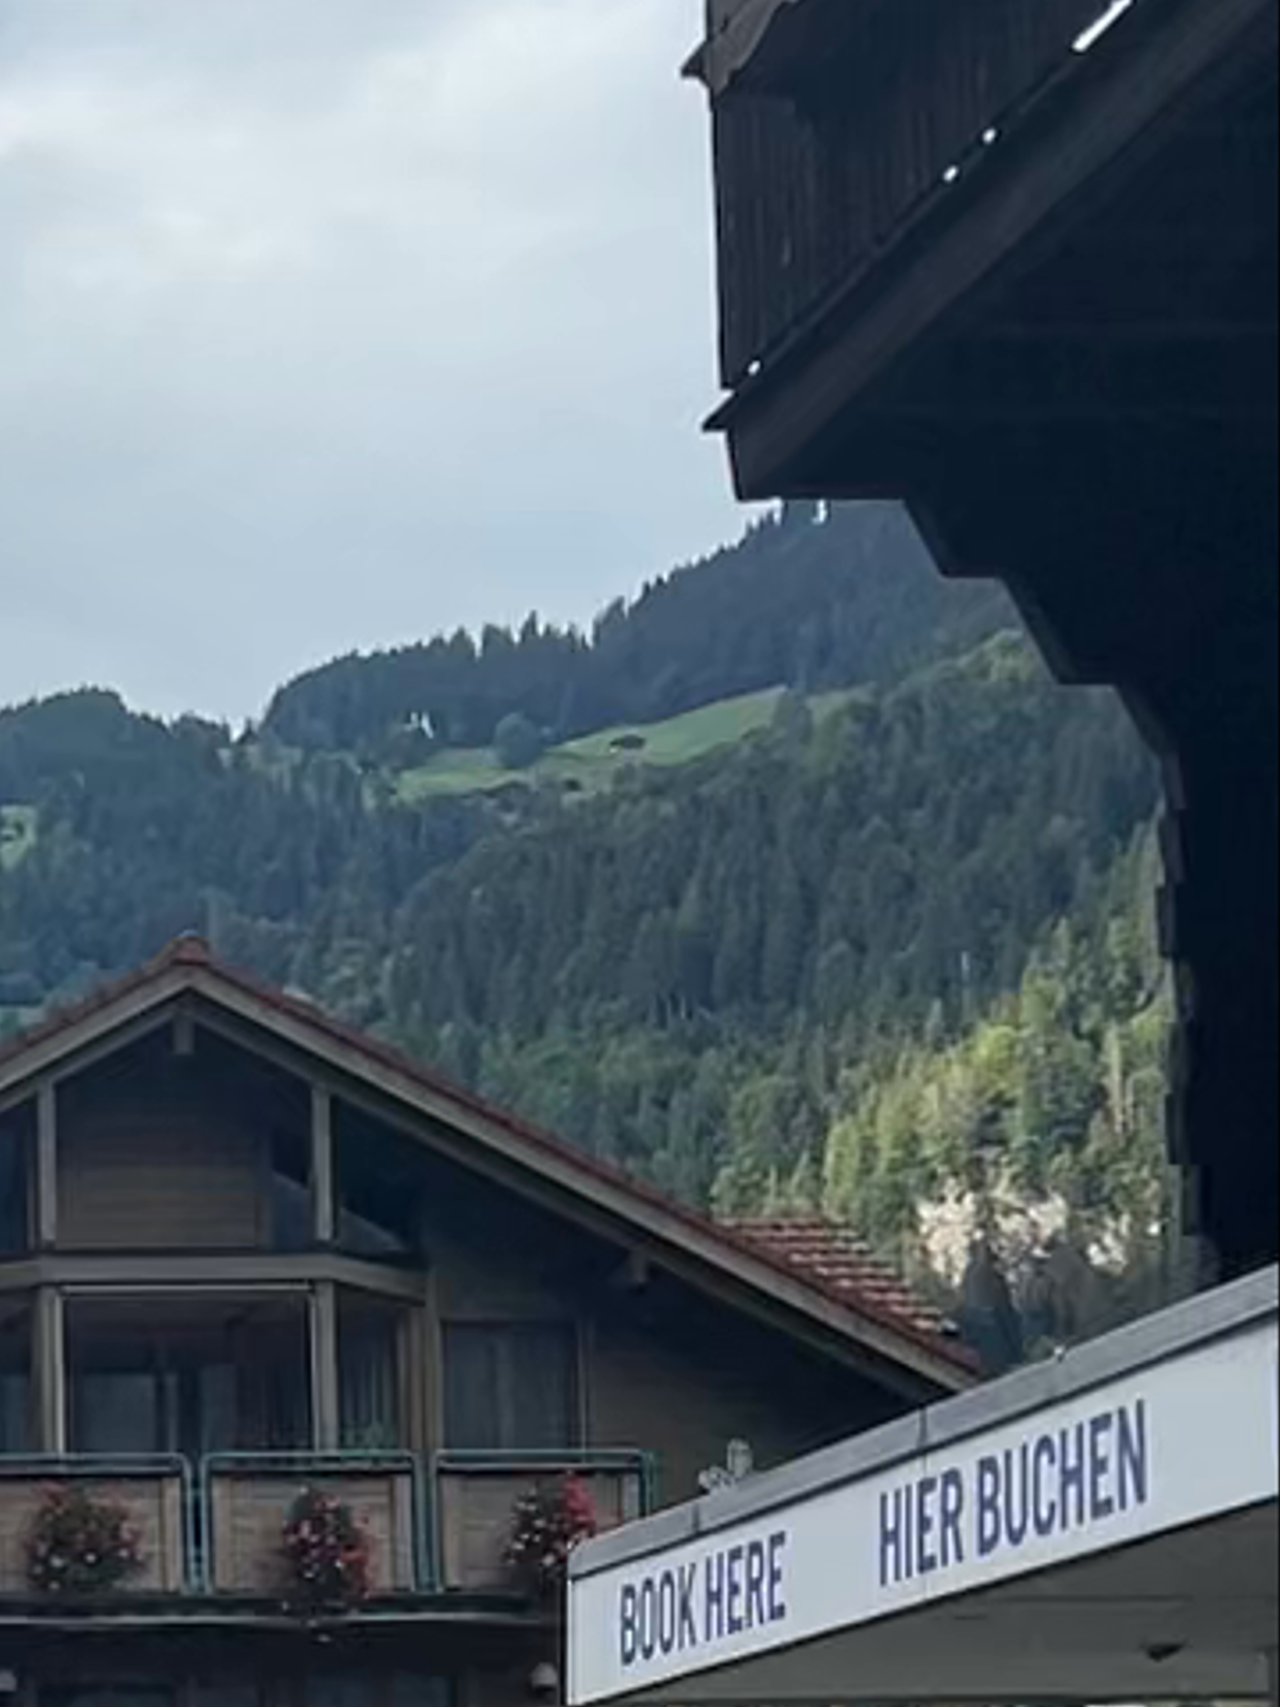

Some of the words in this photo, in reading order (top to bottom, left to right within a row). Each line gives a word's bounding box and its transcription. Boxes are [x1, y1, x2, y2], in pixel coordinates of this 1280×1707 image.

[880, 1467, 963, 1587] HIER
[977, 1398, 1145, 1556] BUCHEN
[621, 1562, 696, 1666] BOOK
[705, 1530, 785, 1642] HERE
